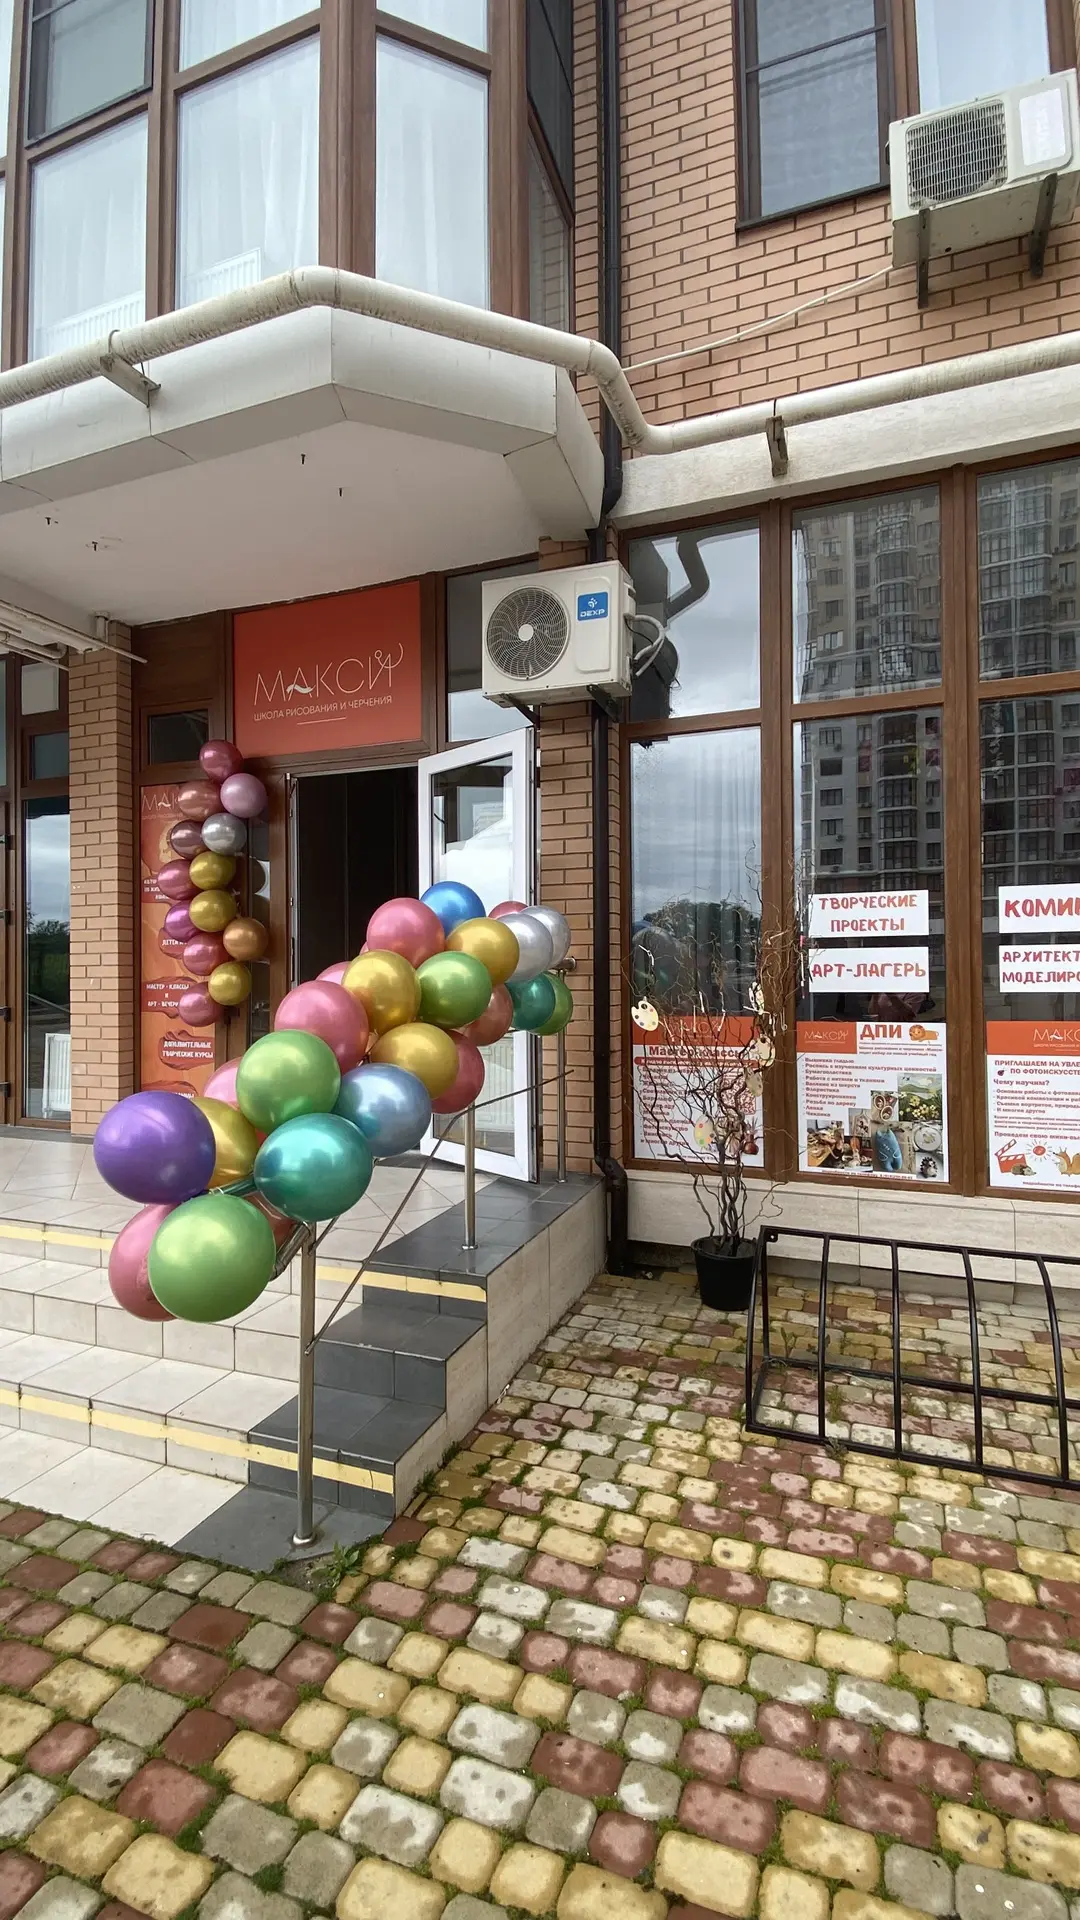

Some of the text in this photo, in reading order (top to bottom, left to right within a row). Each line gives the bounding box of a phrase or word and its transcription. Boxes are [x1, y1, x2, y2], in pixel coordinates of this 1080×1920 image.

[580, 608, 605, 618] DEXP
[254, 695, 393, 722] ШКОЛА РИСОВАНИЯ И ЧЕРЧЕНИЯ
[818, 894, 918, 910] ТВОРЧЕСКИЕ
[830, 918, 904, 932] ПРОЕКТЫ
[812, 962, 926, 978] АРТ-ЛАГЕРЬ
[860, 1024, 902, 1040] ДПИ
